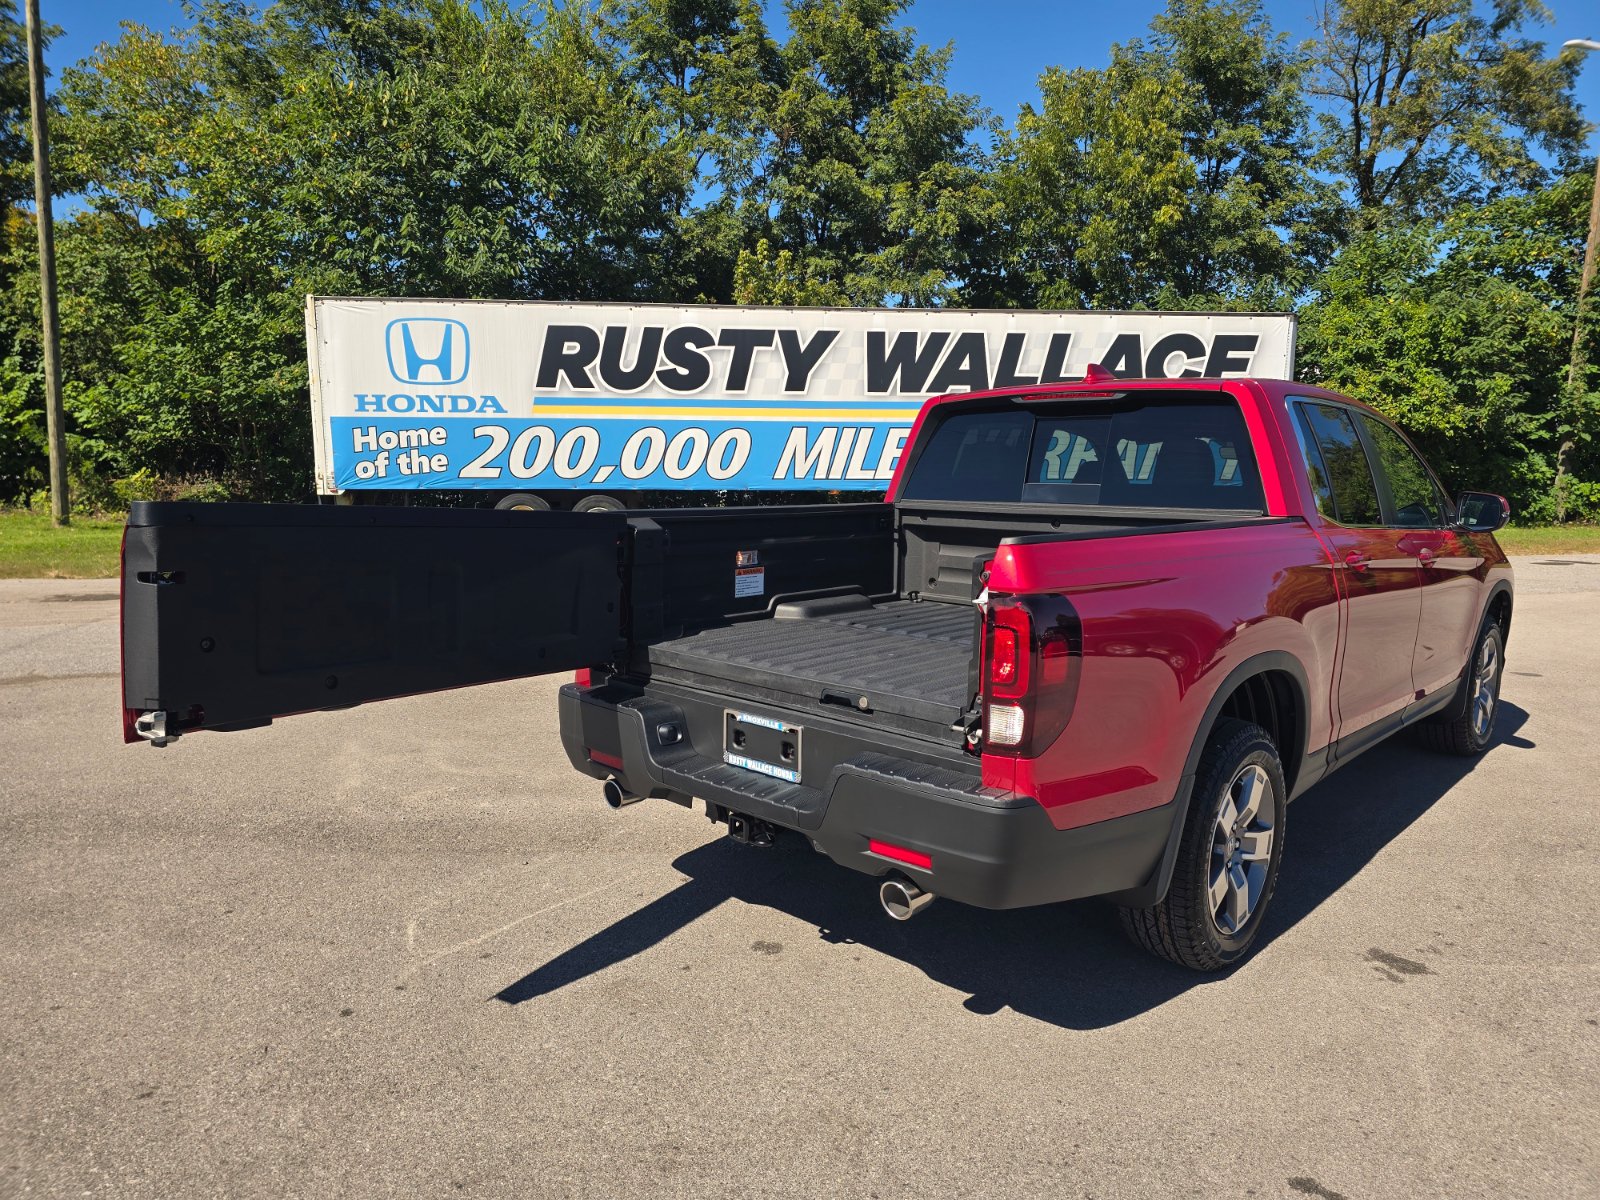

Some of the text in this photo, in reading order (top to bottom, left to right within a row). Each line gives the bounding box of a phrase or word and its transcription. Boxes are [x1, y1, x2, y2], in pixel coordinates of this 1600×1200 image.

[535, 325, 1260, 393] RUSTY WALLACE
[353, 394, 507, 414] HONDA
[352, 425, 448, 453] Home
[354, 451, 390, 480] of
[396, 447, 450, 477] the
[458, 424, 753, 484] 200,000
[743, 714, 779, 730] KNOXVILLE
[747, 758, 773, 775] WALLACE
[773, 766, 793, 781] HONDA
